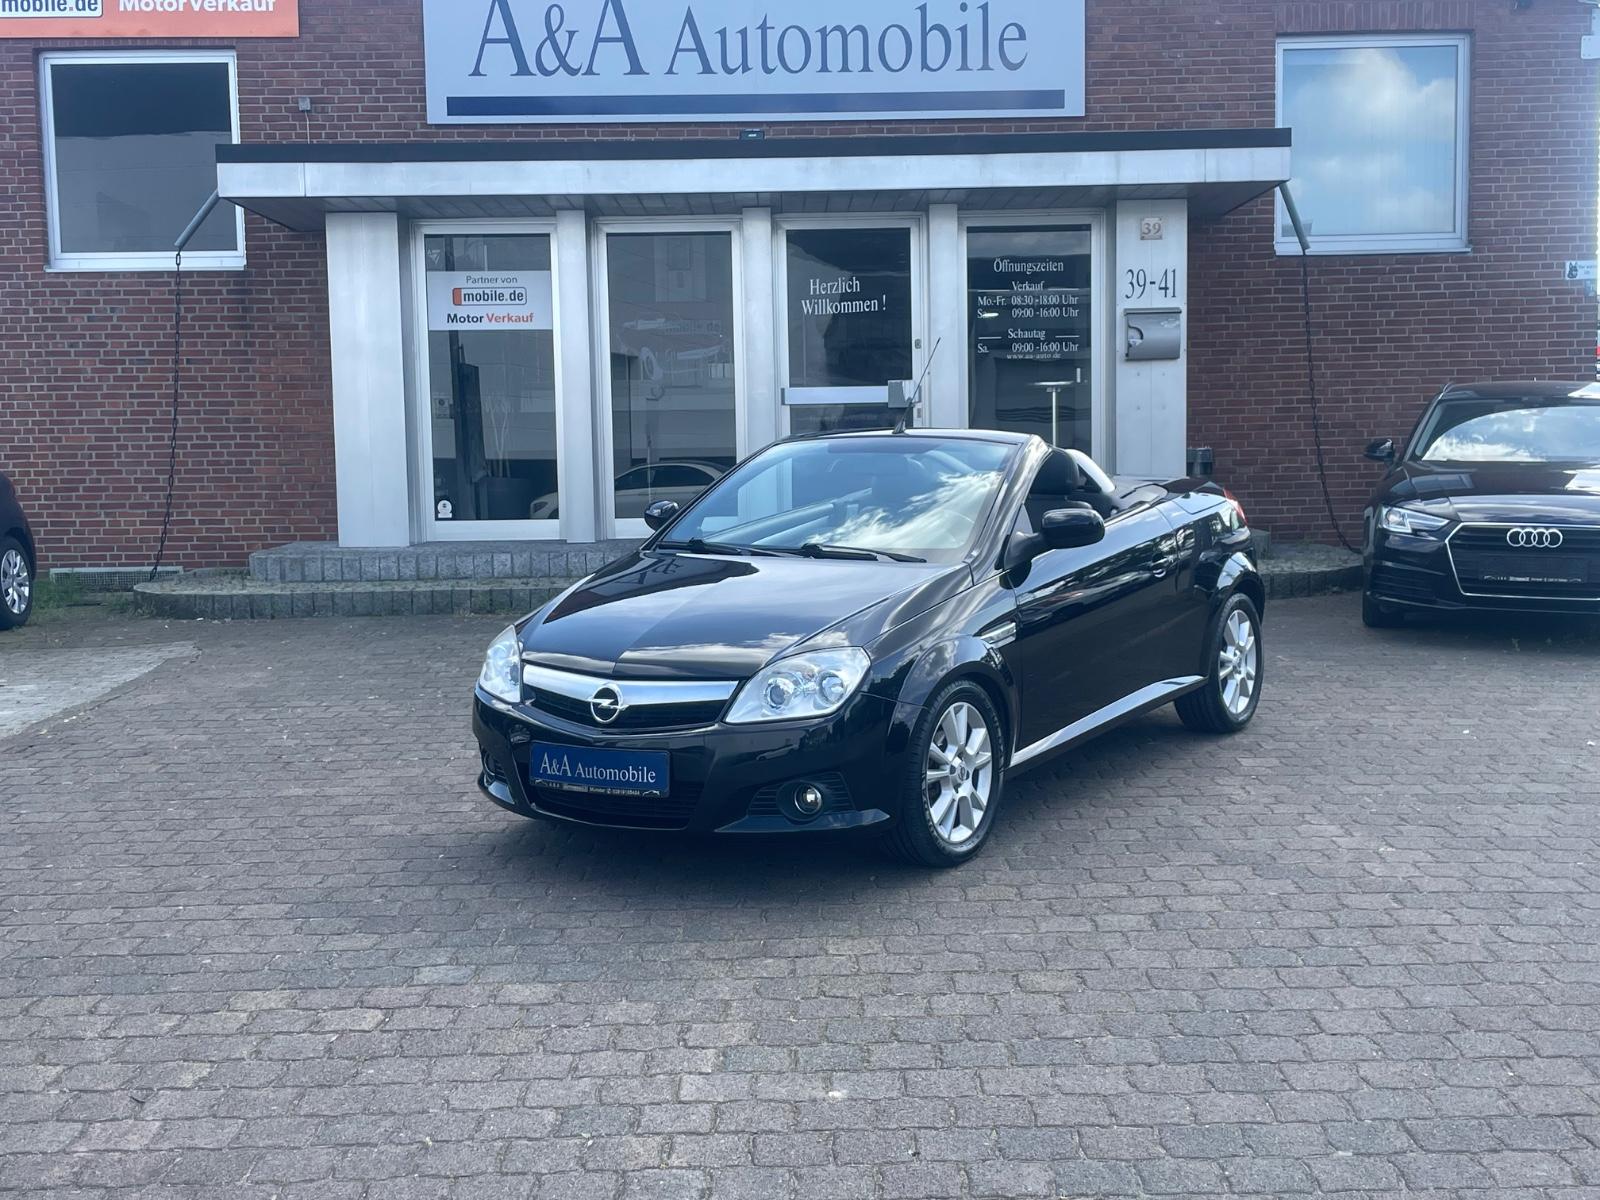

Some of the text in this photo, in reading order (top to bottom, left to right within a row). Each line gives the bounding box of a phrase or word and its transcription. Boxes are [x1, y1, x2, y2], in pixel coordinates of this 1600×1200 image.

[468, 0, 1028, 77] A&A Automobile
[1142, 222, 1162, 236] 39
[993, 258, 1064, 275] Öffnungszeiten
[466, 275, 518, 284] Partner von
[810, 276, 861, 295] Herzlich
[1012, 280, 1045, 291] Verkauf
[1124, 268, 1177, 300] 39-41
[463, 290, 524, 302] mobile.de
[1062, 294, 1080, 305] Uhr
[801, 298, 879, 315] Willkommen
[1062, 307, 1080, 317] Uhr
[446, 312, 535, 324] Motor Verkauf
[1008, 328, 1046, 340] Schautag
[1062, 341, 1080, 352] Uhr
[539, 752, 657, 784] A&A Automobile
